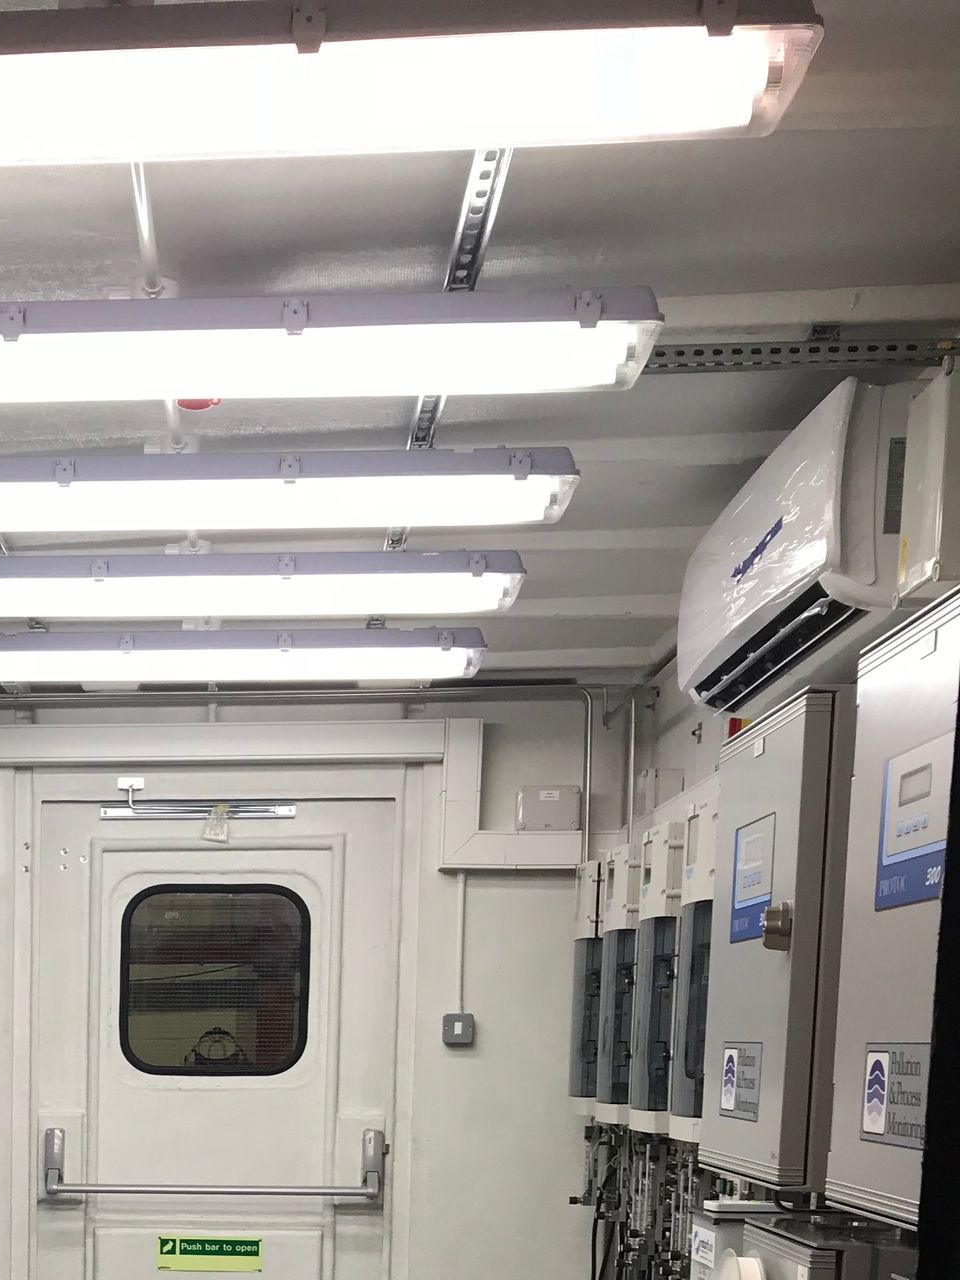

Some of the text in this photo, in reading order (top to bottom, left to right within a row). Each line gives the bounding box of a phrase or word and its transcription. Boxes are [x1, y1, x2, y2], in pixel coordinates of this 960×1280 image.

[890, 1051, 921, 1076] Pollution
[886, 1112, 926, 1146] Monitoring
[181, 1242, 202, 1251] Push
[205, 1243, 220, 1251] bar
[235, 1244, 258, 1253] open
